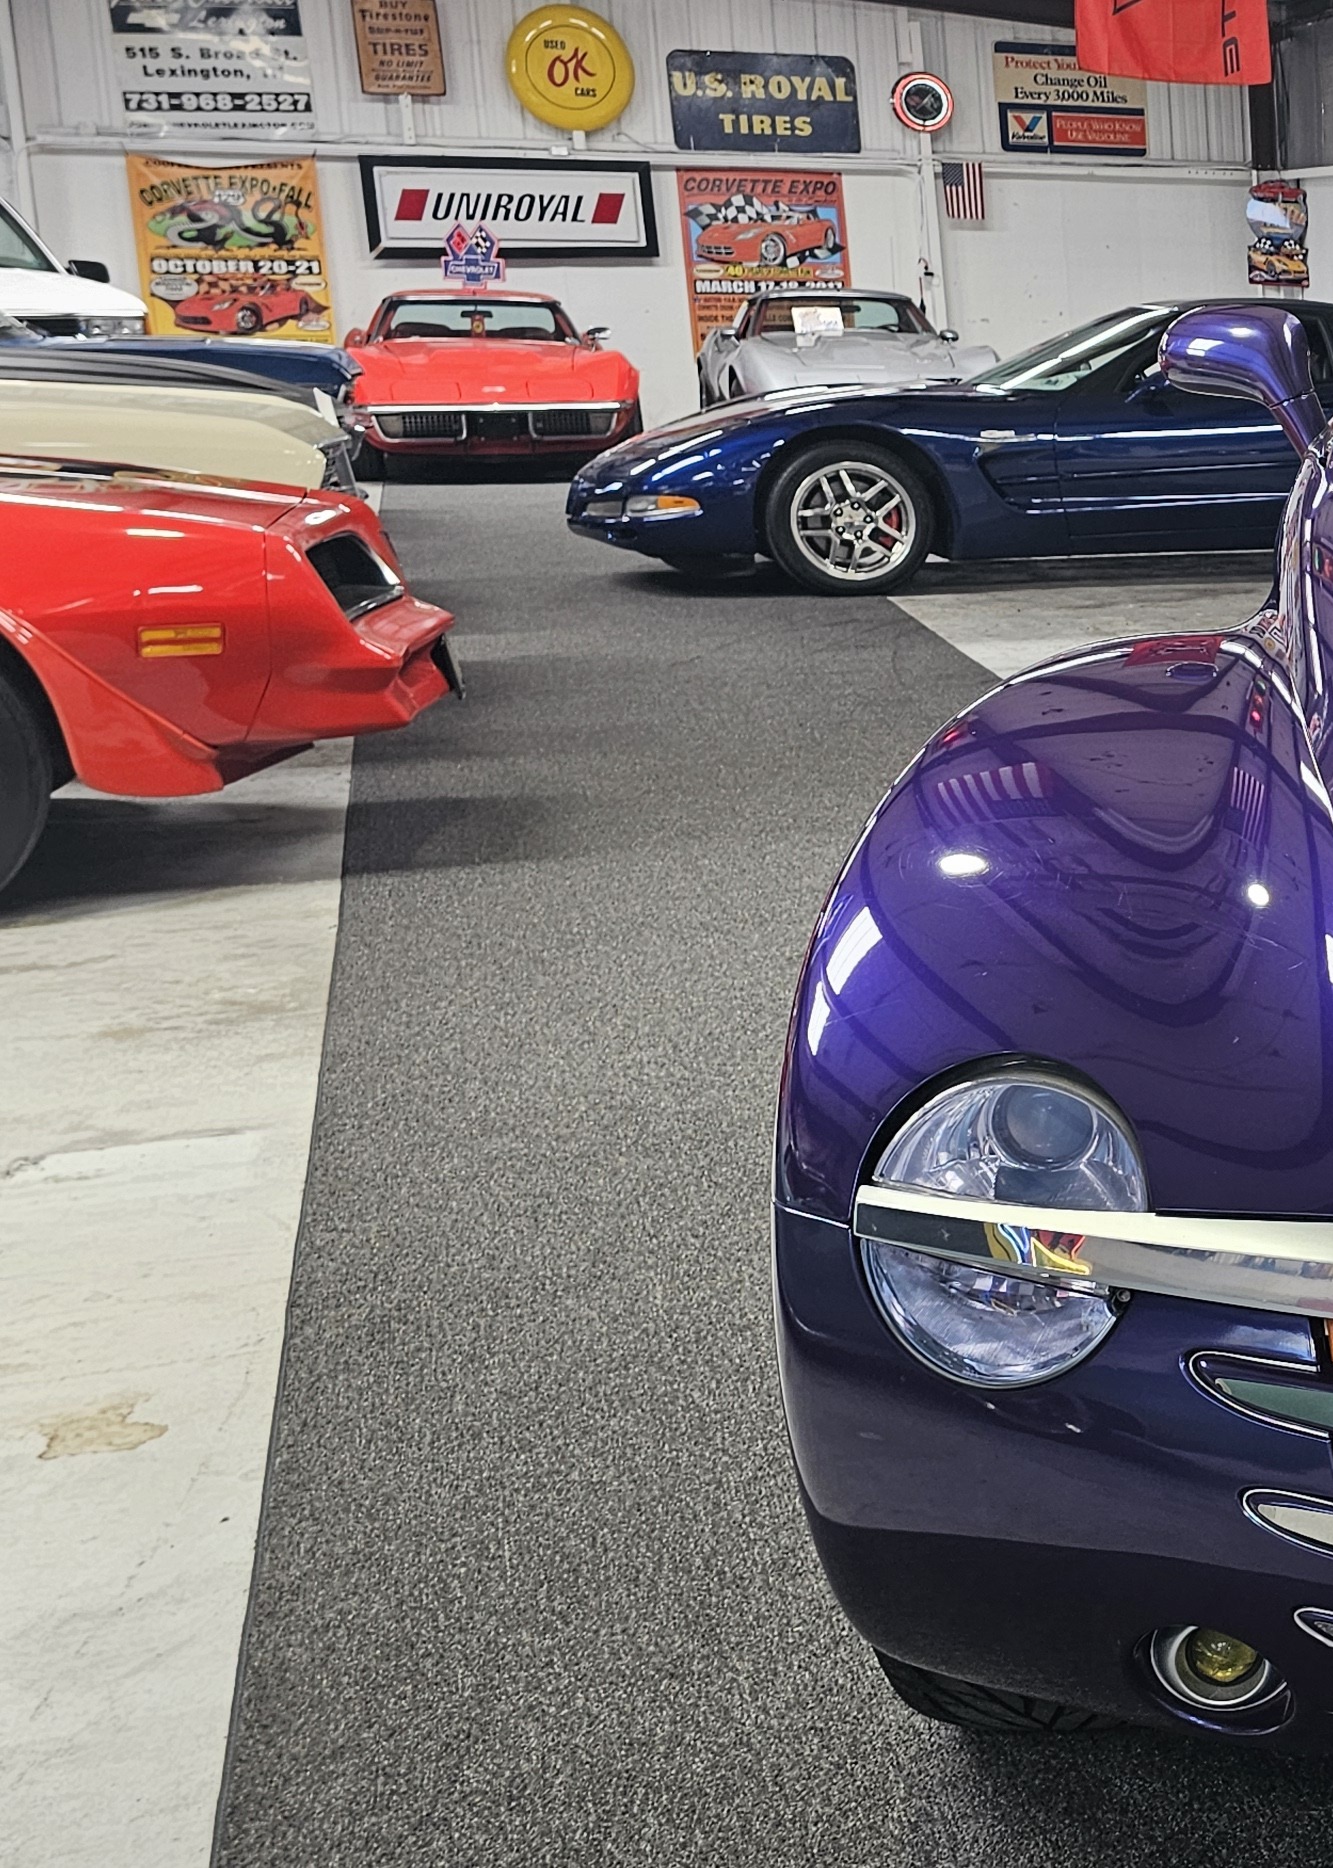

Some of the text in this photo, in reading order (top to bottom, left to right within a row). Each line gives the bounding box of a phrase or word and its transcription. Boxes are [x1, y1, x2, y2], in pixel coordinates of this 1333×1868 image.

[359, 9, 430, 22] Firestone
[125, 46, 160, 60] 515
[171, 46, 191, 60] S.
[368, 42, 429, 57] TIRES
[543, 39, 566, 50] USED
[547, 46, 598, 88] OK
[1004, 56, 1051, 70] Protect
[143, 64, 251, 80] Lexington,
[1033, 72, 1108, 89] Change Oil
[574, 87, 598, 98] CARS
[670, 71, 854, 102] U.S. ROYAL
[125, 92, 309, 111] 731-968-2527
[1014, 87, 1052, 104] Every
[1091, 91, 1128, 104] Miles
[718, 113, 814, 137] TIRES
[139, 174, 225, 207] CORVETTE
[683, 176, 837, 195] CORVETTE EXPO
[431, 192, 586, 222] UNIROYAL
[151, 258, 321, 275] OCTOBER 20-21
[449, 265, 495, 275] CHEVROLET
[695, 280, 756, 294] MARCH
